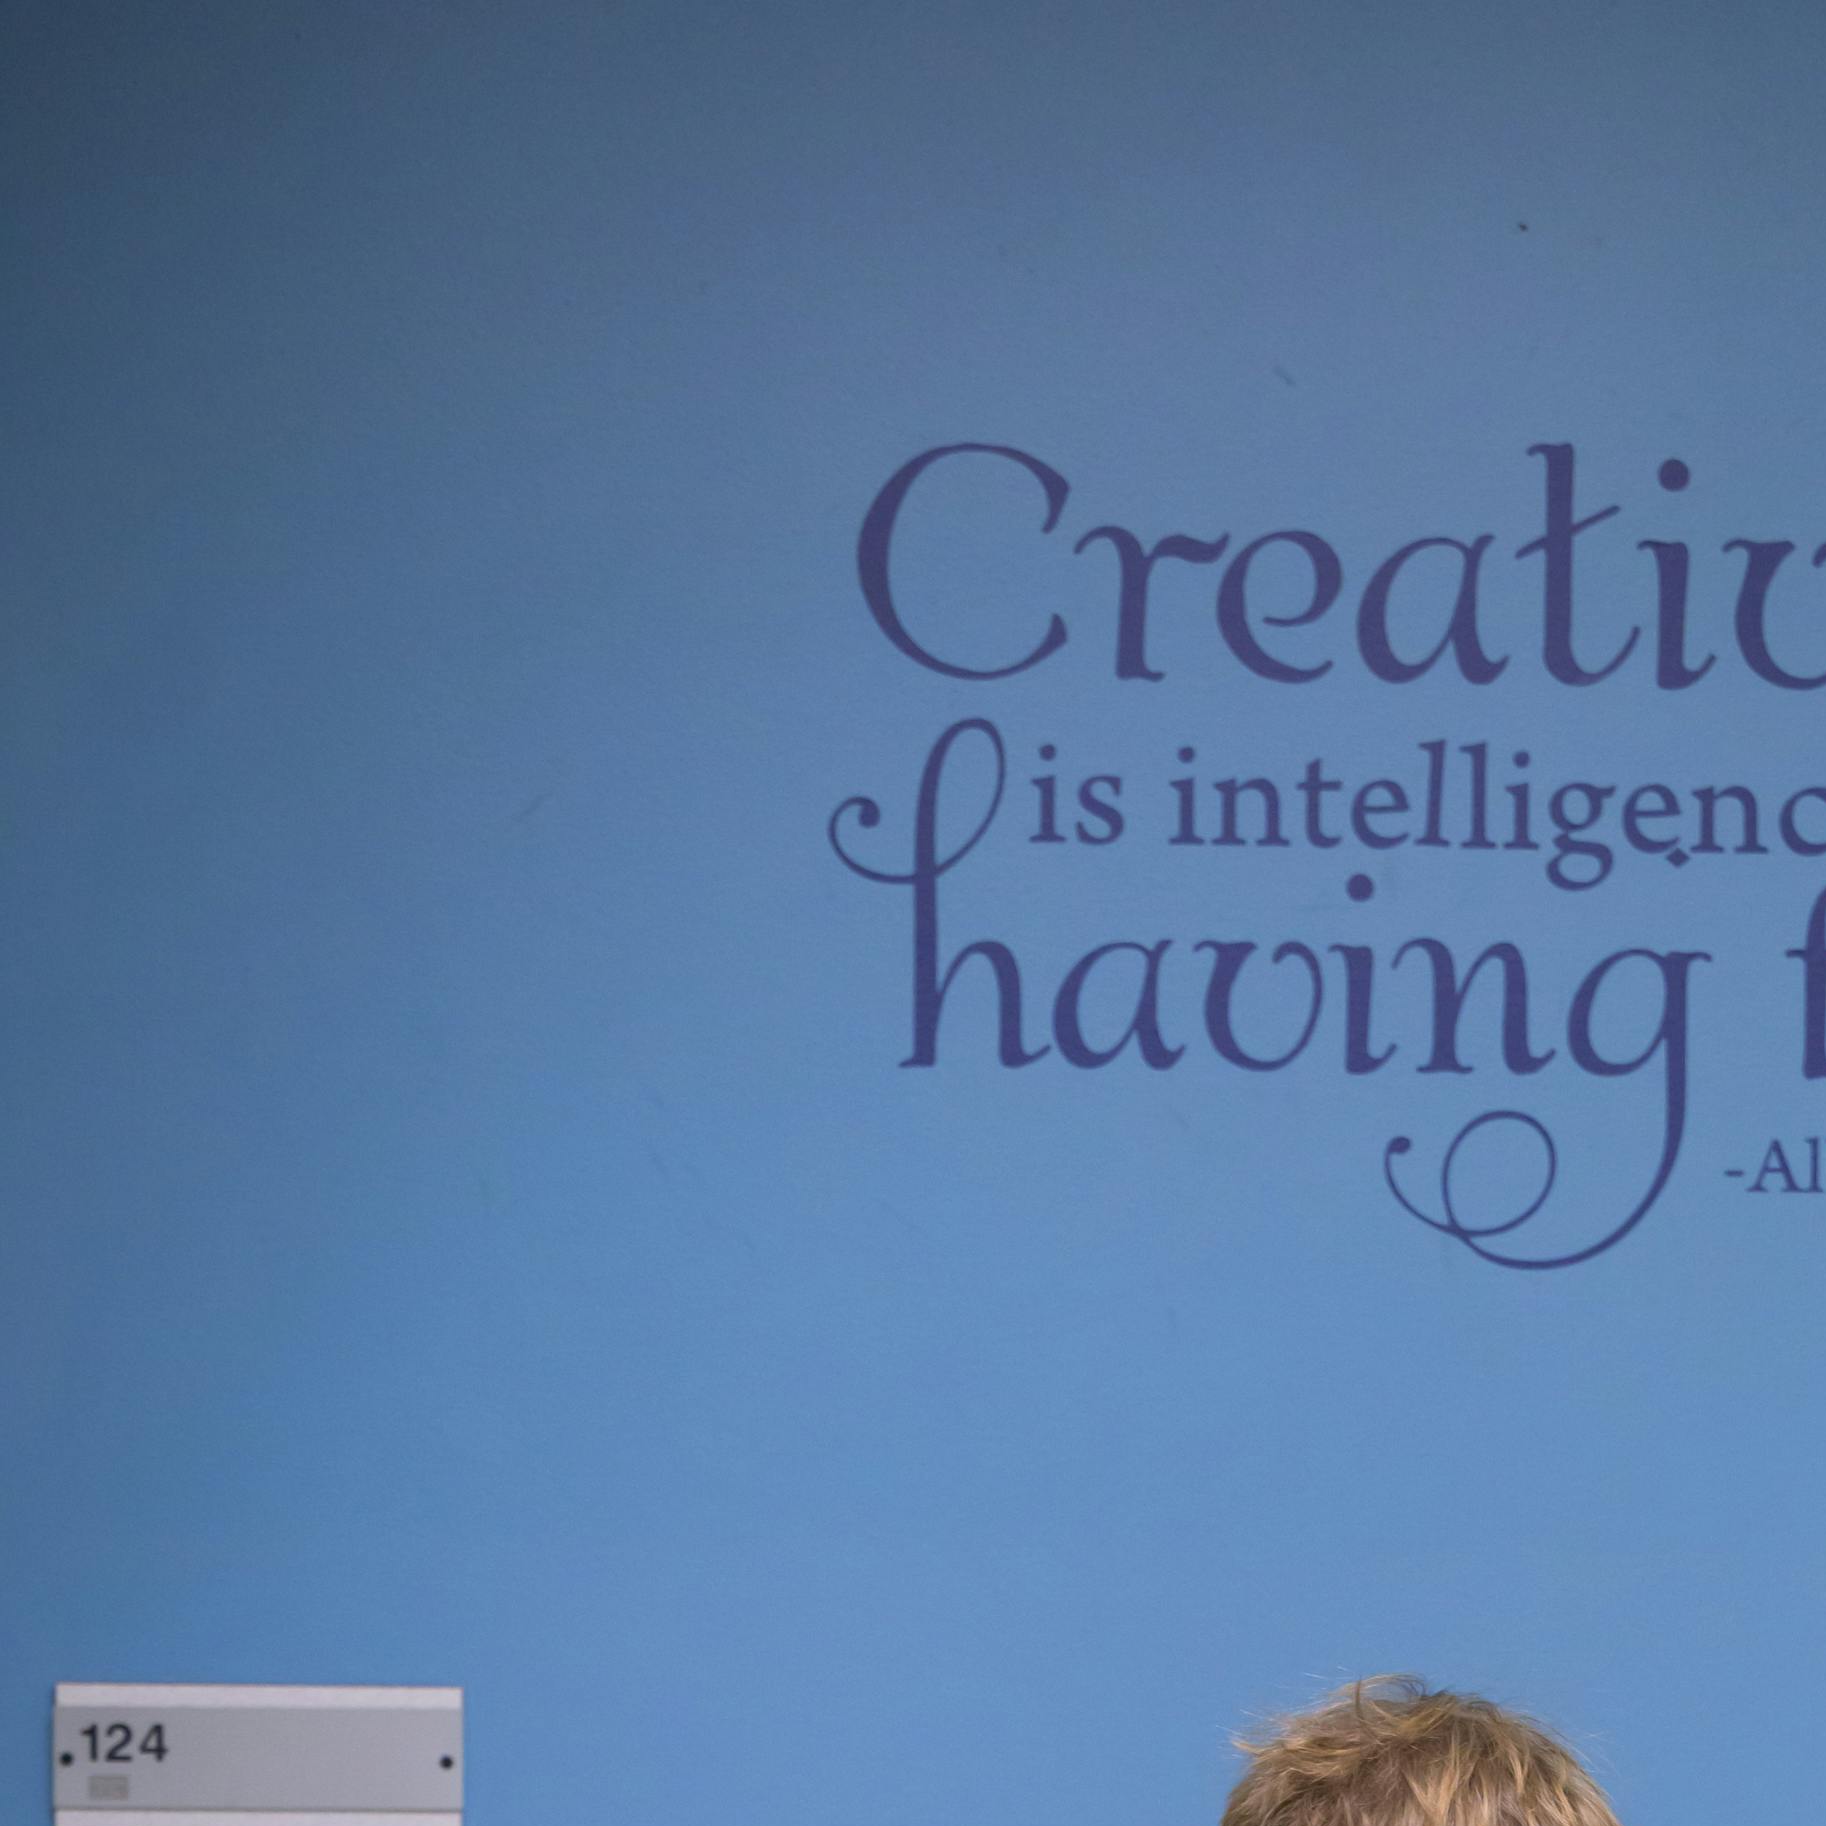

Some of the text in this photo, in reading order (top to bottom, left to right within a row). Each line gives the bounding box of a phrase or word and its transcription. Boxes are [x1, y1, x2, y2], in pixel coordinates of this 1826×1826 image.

[1029, 743, 1125, 848] is
[827, 717, 1712, 1271] having
[80, 1723, 169, 1763] 124
